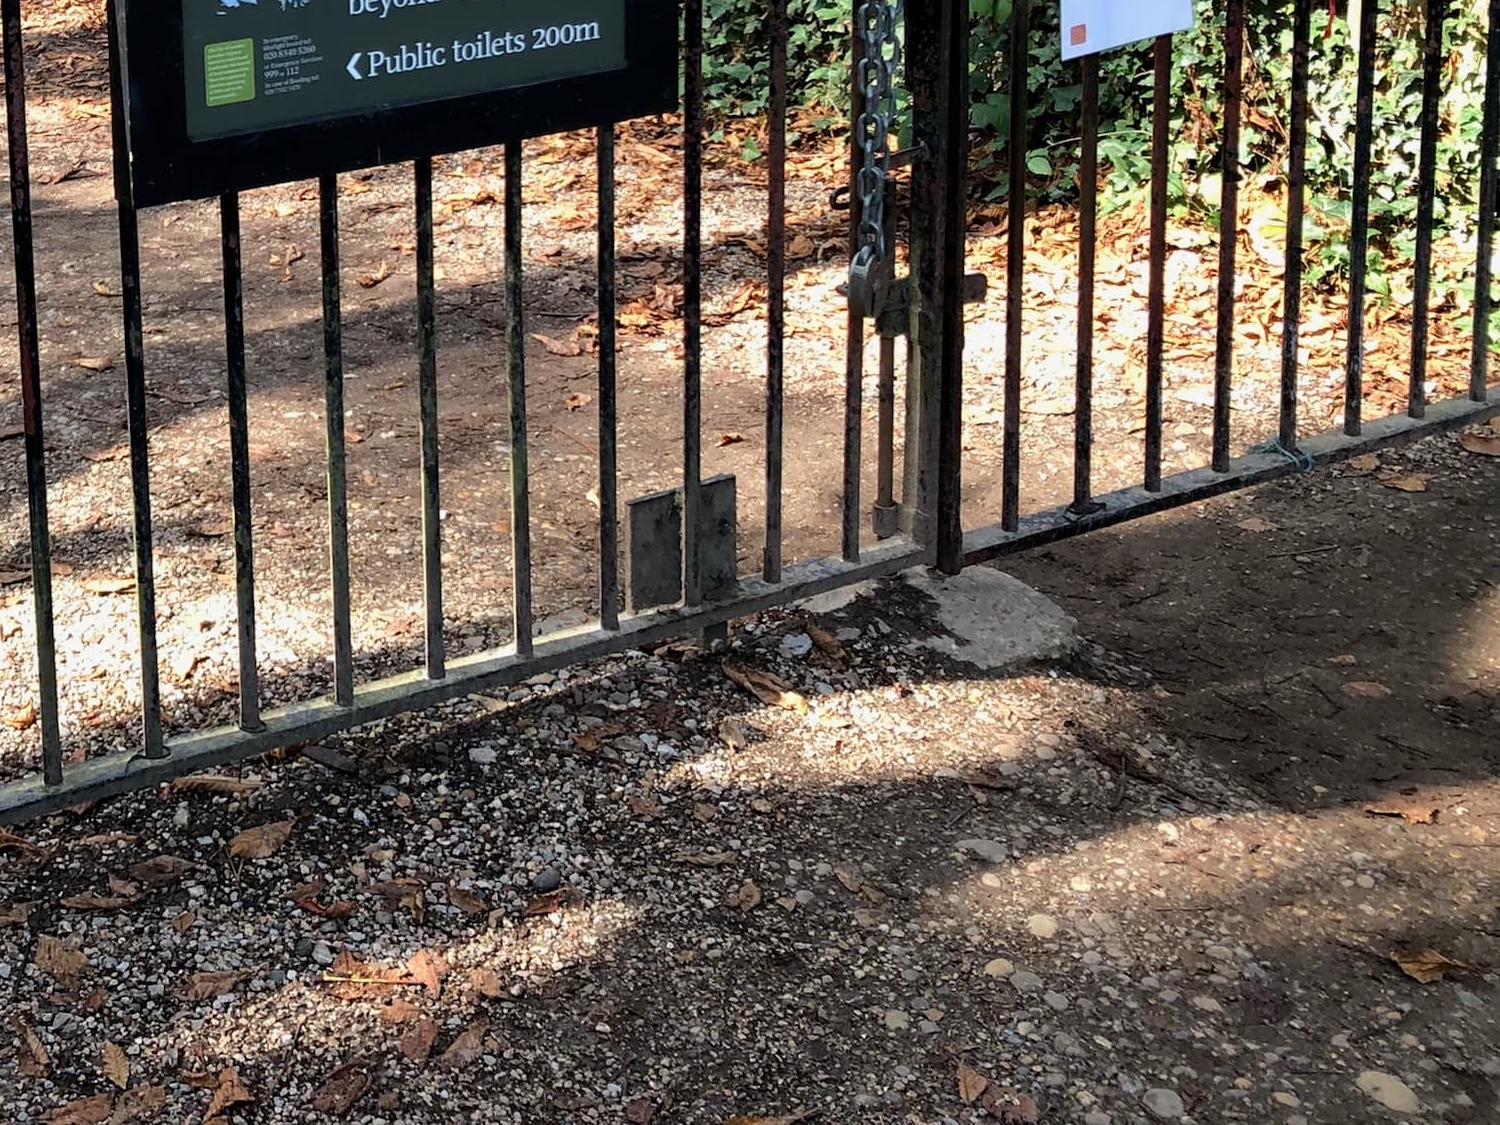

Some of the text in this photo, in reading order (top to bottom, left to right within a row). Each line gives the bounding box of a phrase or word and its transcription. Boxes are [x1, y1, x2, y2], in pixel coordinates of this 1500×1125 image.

[367, 20, 600, 77] Public toilets 200m
[264, 70, 278, 79] 999
[286, 67, 299, 75] 112
